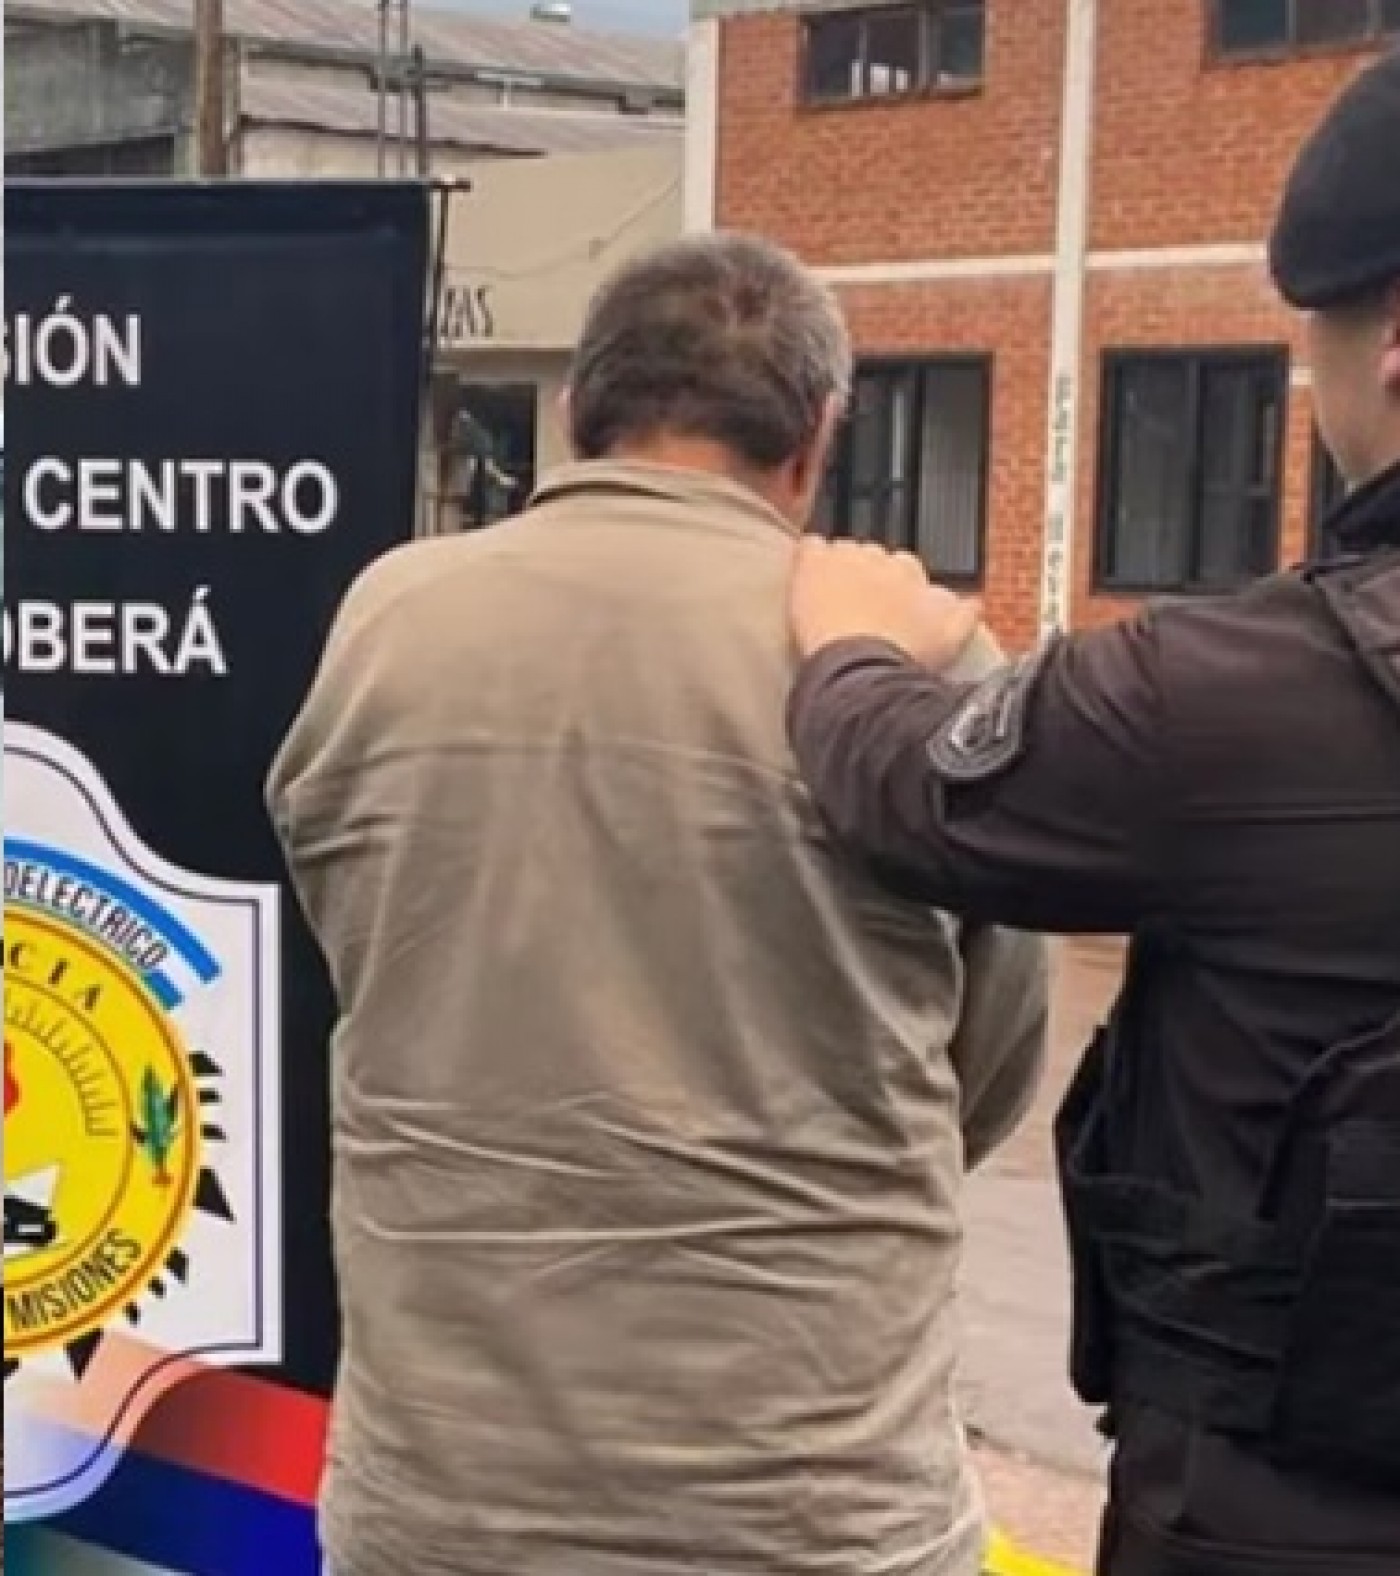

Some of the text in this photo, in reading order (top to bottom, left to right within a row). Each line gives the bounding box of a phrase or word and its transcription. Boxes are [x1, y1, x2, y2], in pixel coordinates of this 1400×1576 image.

[3, 295, 141, 386] IÓN
[23, 457, 338, 533] CENTRO
[3, 585, 228, 674] BERÁ
[6, 1227, 141, 1333] MISIONES
